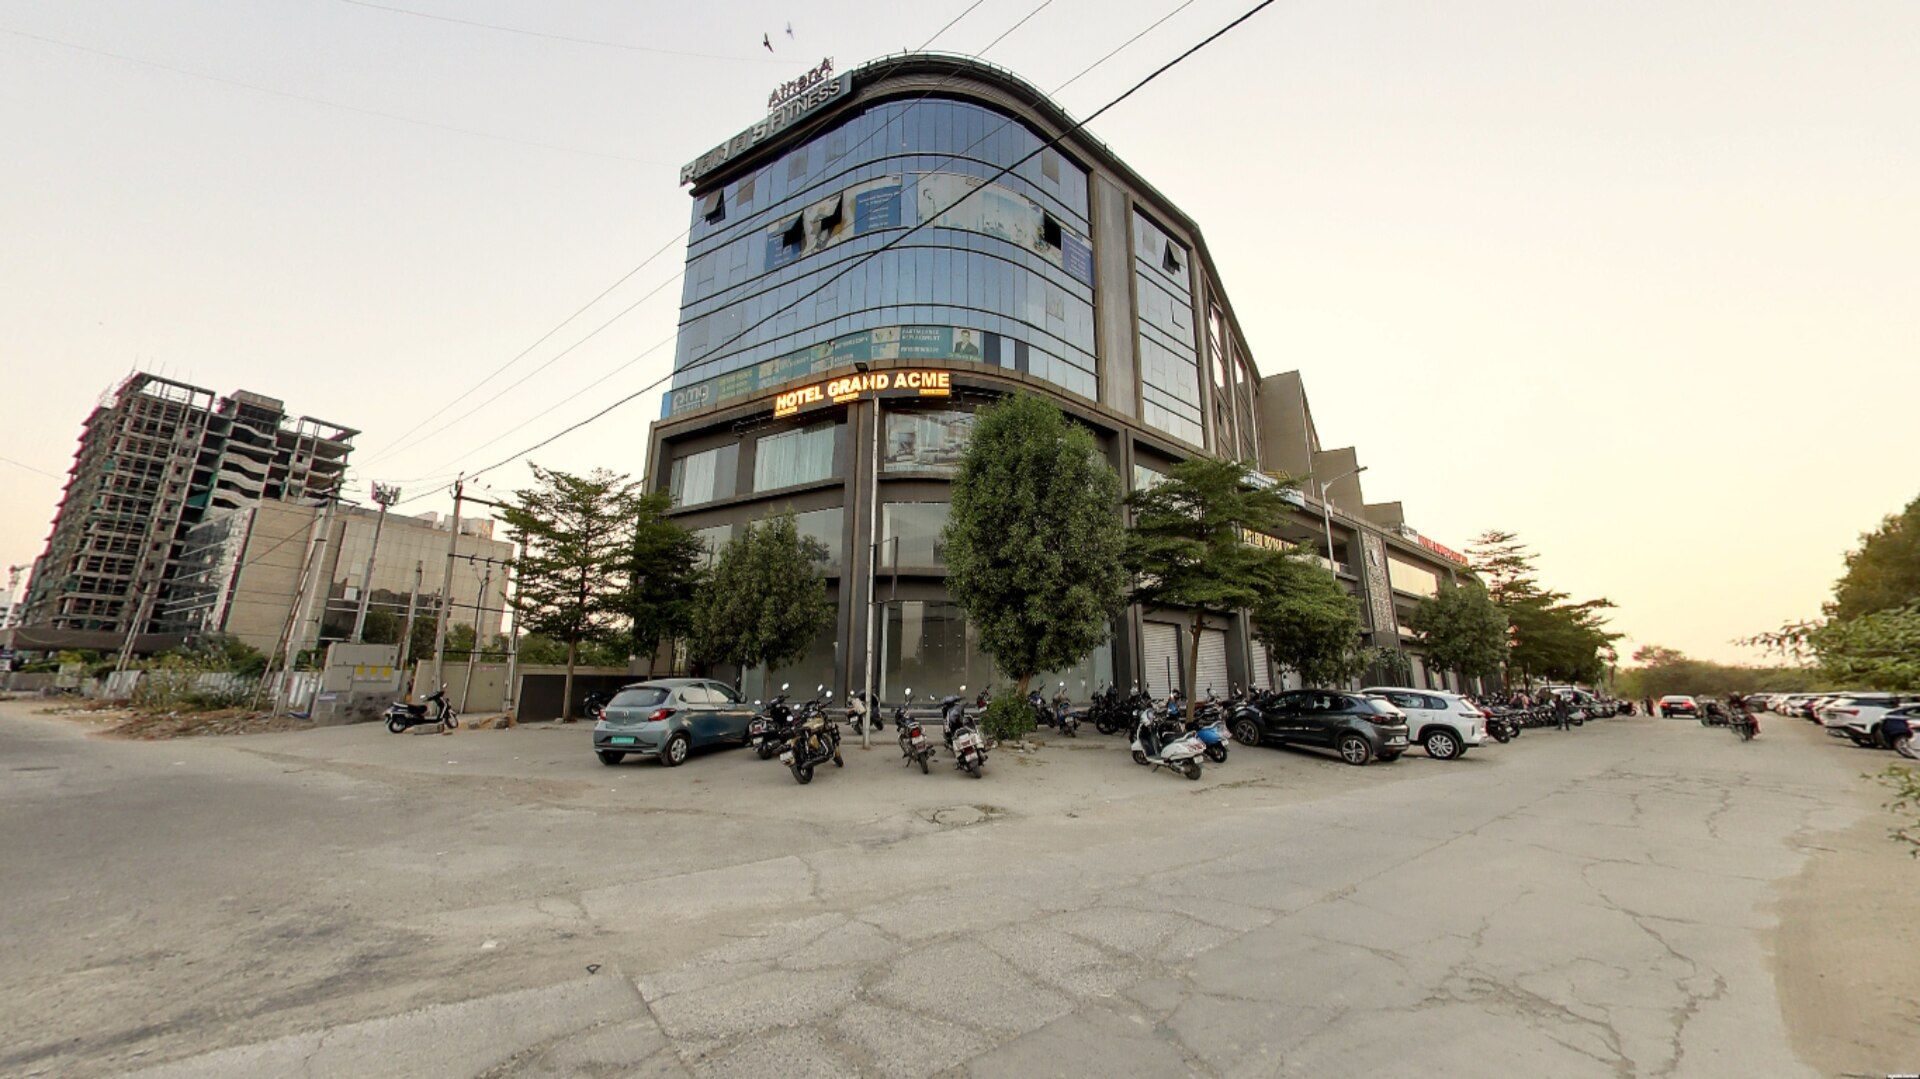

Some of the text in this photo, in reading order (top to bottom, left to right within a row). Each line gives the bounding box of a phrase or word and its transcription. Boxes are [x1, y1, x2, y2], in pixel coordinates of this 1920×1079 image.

[771, 79, 841, 132] FITNESS
[776, 386, 824, 410] HOTEL
[827, 373, 889, 397] GRAND
[893, 372, 950, 388] ACME
